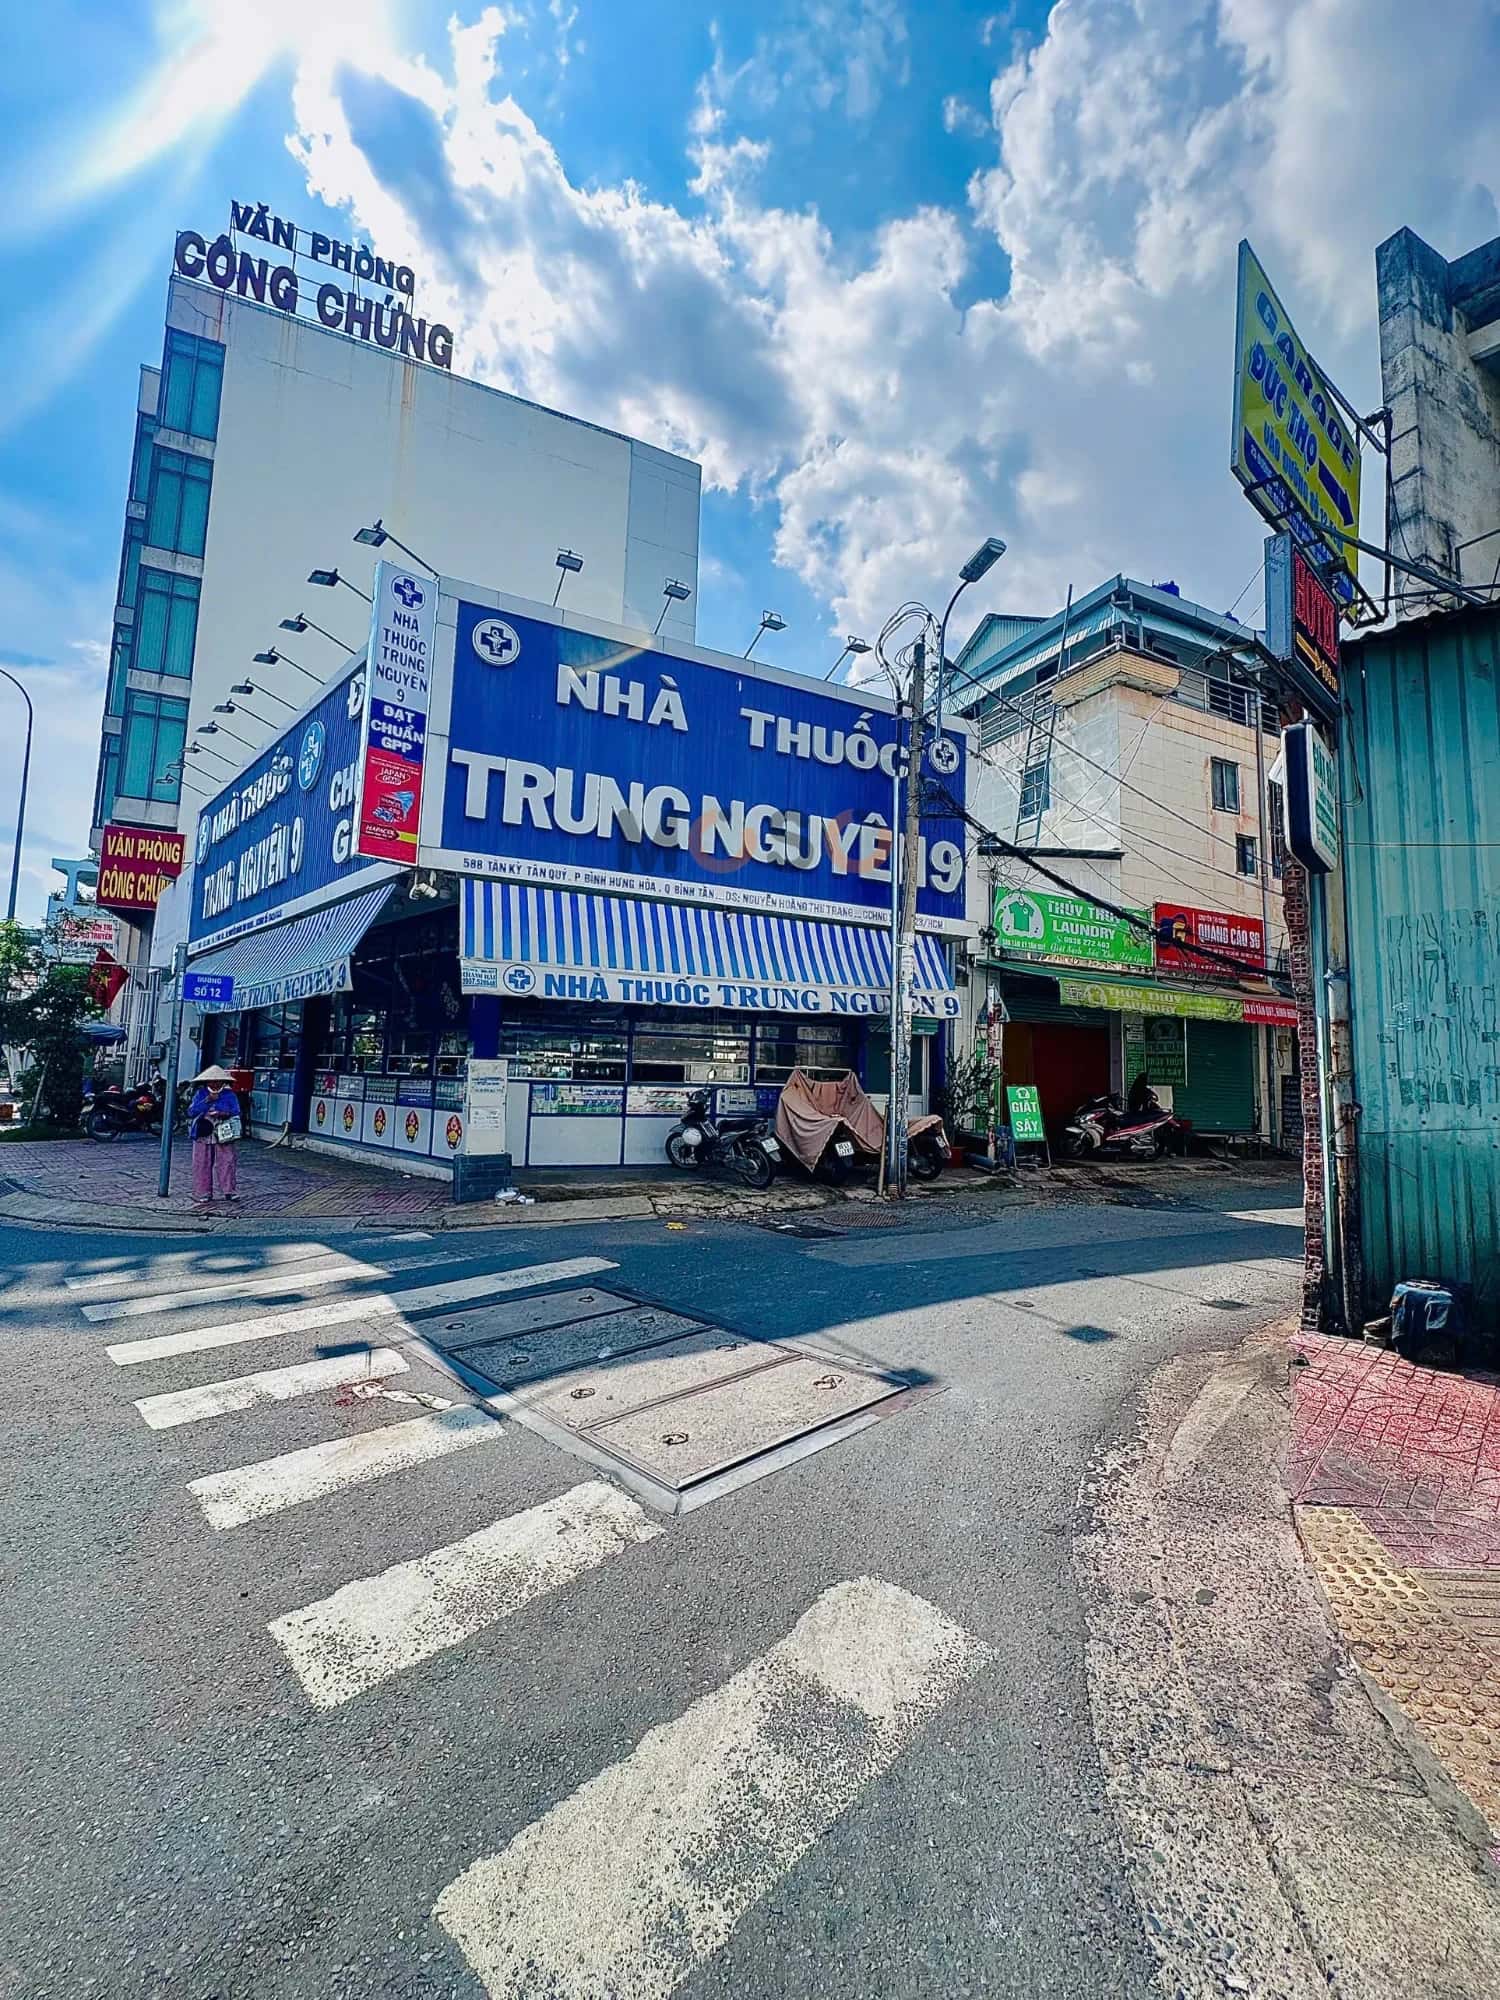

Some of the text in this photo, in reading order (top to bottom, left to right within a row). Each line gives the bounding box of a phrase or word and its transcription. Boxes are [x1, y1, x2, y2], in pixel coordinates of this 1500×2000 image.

[231, 200, 415, 296] VĂN PHÒNG
[175, 231, 454, 369] CÔNG CHỨNG
[1257, 291, 1354, 472] GARAGE
[393, 610, 419, 632] NHÀ
[383, 628, 427, 655] THUỐC
[382, 646, 425, 673] TRUNG
[376, 663, 427, 692] NGUYÊN
[396, 689, 405, 703] 9
[383, 704, 415, 723] ĐẠT
[556, 664, 910, 778] NHÀ THUỐC
[371, 719, 424, 744] CHUẨN
[381, 736, 412, 753] GPP
[380, 768, 406, 780] JAPAN
[212, 747, 293, 843] NHÀ THUỐC
[452, 748, 691, 850] TRUNG
[930, 841, 963, 893] 9
[107, 831, 181, 863] VĂN PHÒNG
[203, 817, 304, 919] TRUNG NGUYÊN 9
[488, 858, 507, 874] TÂN
[527, 864, 546, 879] TÂN
[575, 871, 581, 882] P
[584, 871, 606, 886] BÌNH
[609, 874, 635, 889] HƯNG
[674, 882, 695, 897] BÌNH
[101, 864, 171, 902] CÔNG CHỨ
[1053, 919, 1116, 940] LAUNDRY
[1198, 922, 1229, 944] QUẢNG
[1231, 925, 1248, 947] CÁO
[337, 963, 347, 988] 9
[193, 984, 221, 998] SỐ 12
[544, 973, 609, 1000] NHÀ
[619, 975, 709, 1007] THUỐC
[717, 984, 820, 1010] TRUNG
[943, 997, 960, 1016] 9
[1011, 1100, 1038, 1115] GIẶT
[1016, 1117, 1038, 1131] SẤY
